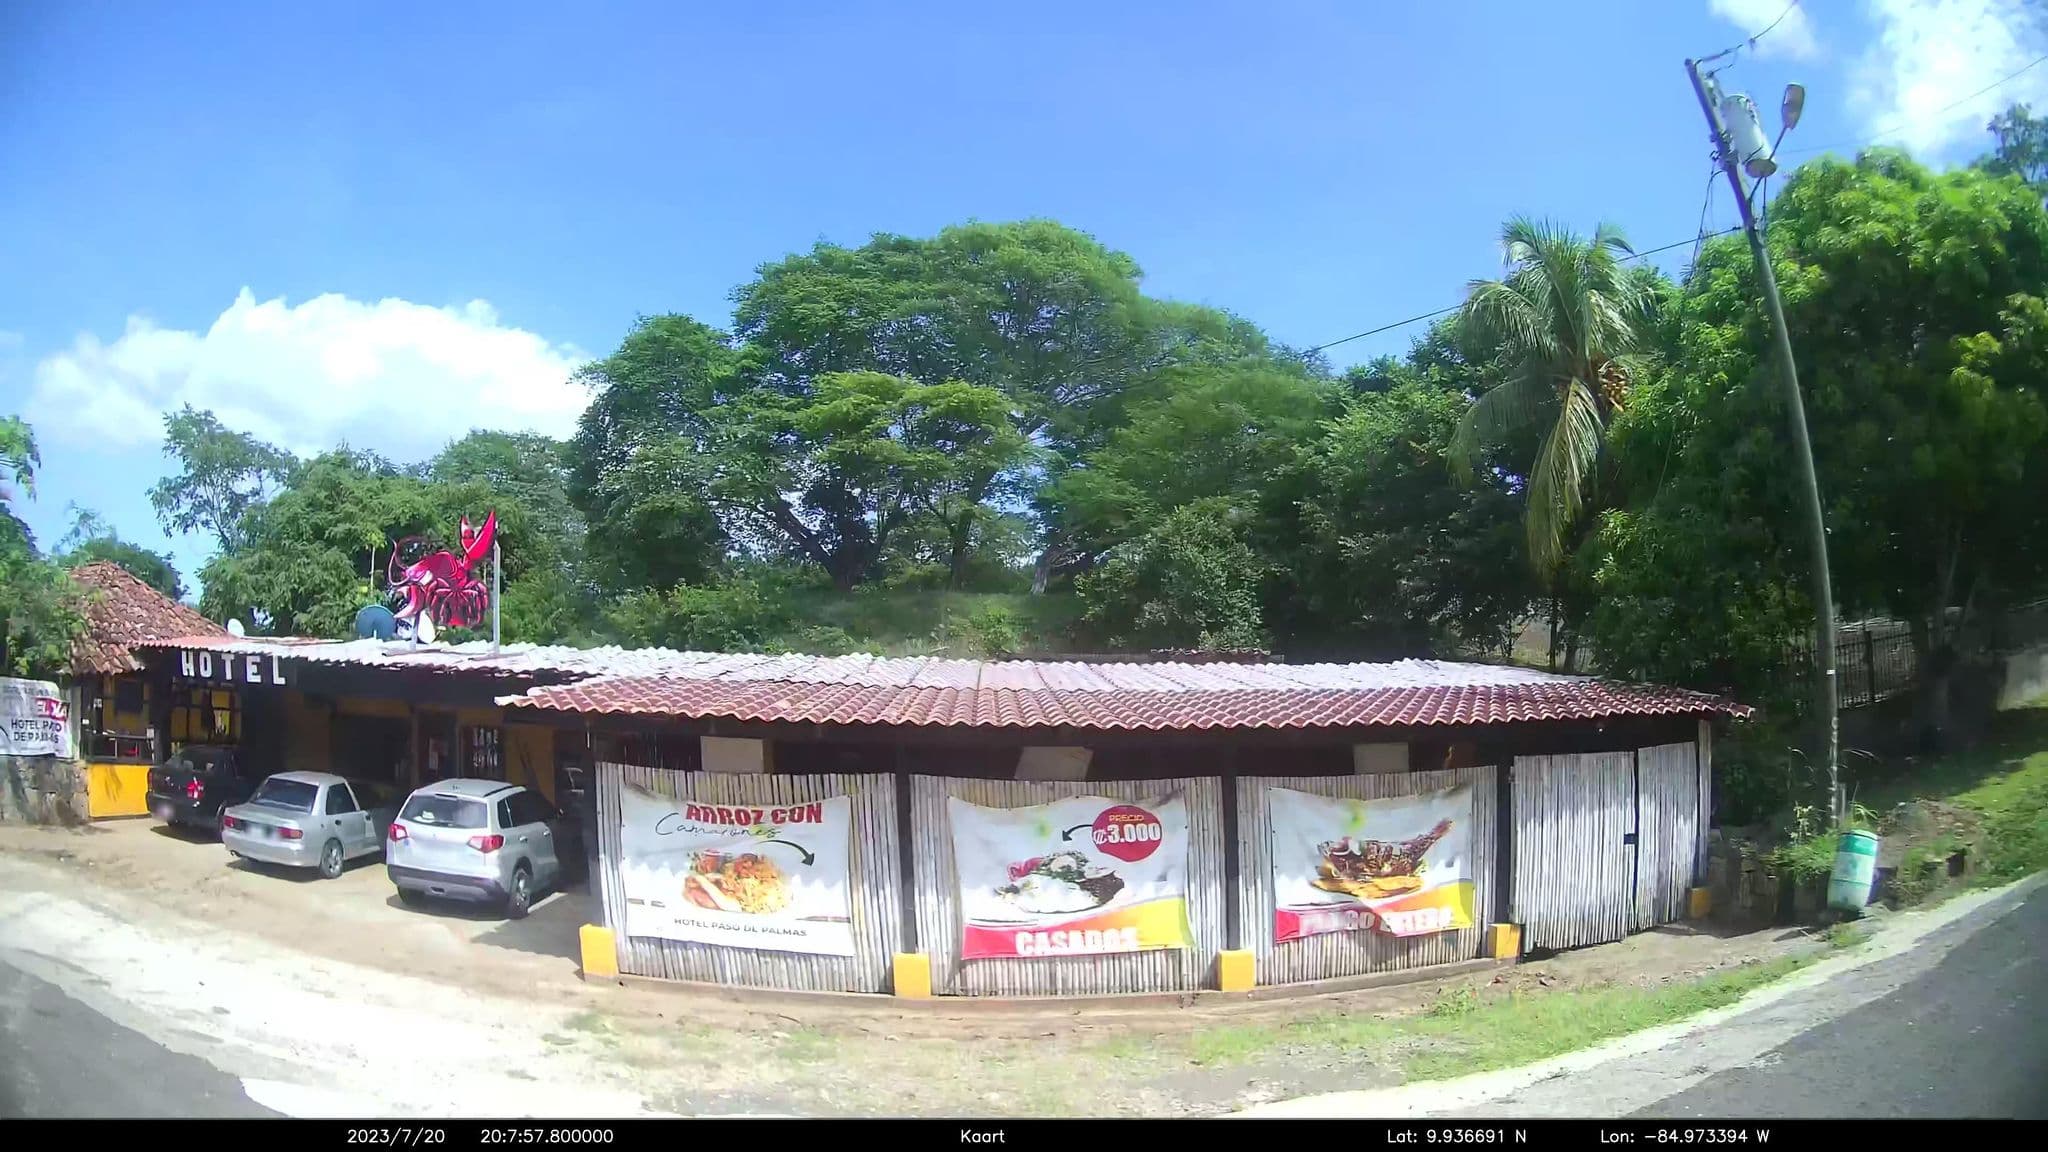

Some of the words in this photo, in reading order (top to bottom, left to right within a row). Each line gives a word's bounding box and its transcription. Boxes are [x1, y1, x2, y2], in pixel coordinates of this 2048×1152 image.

[180, 651, 286, 686] HOTEL
[11, 719, 41, 730] HOTEL
[14, 731, 26, 742] DE
[655, 812, 782, 838] Camarones
[686, 803, 763, 826] ARROZ
[771, 802, 823, 824] CON
[674, 918, 709, 929] HOTEL
[761, 926, 808, 938] PALMAS
